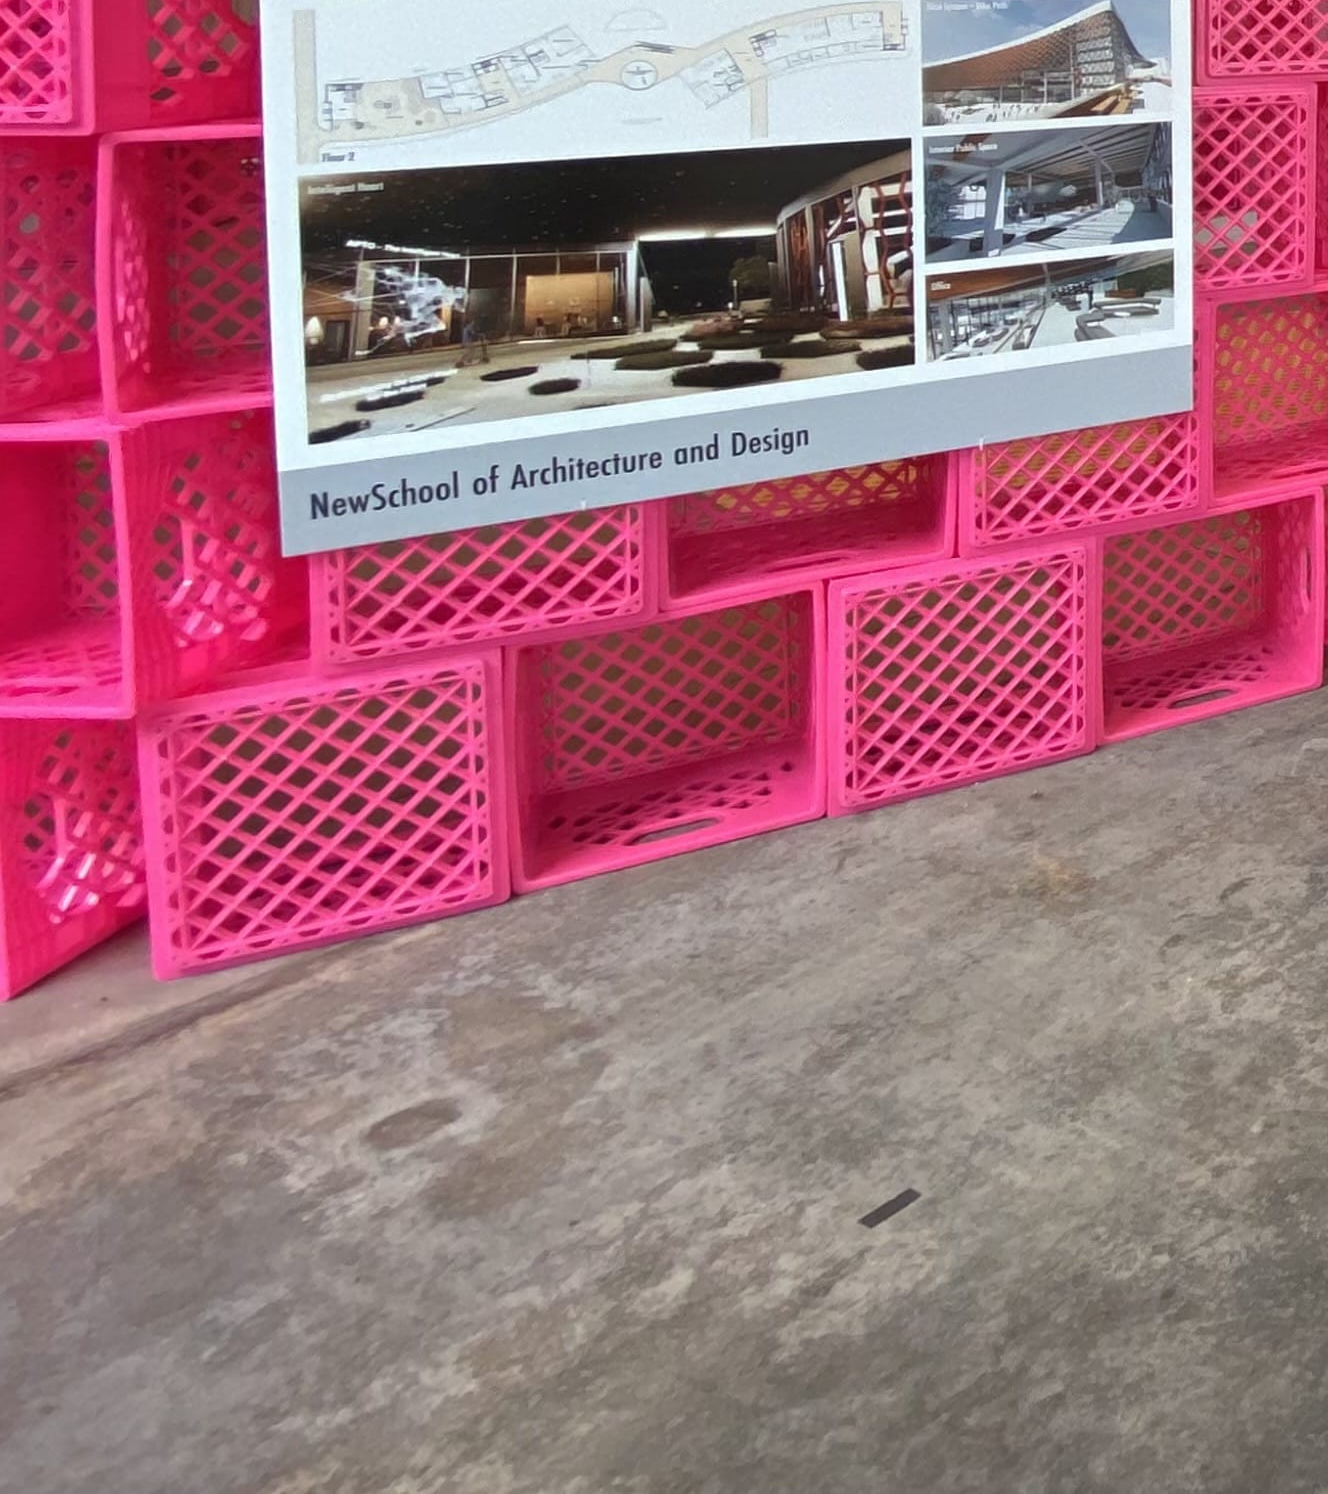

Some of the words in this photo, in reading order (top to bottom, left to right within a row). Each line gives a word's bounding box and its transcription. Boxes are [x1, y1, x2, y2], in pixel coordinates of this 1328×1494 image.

[310, 471, 459, 520] NewSchool
[472, 464, 499, 496] of
[510, 451, 662, 490] Architecture
[674, 433, 719, 465] and
[731, 427, 809, 456] Design
